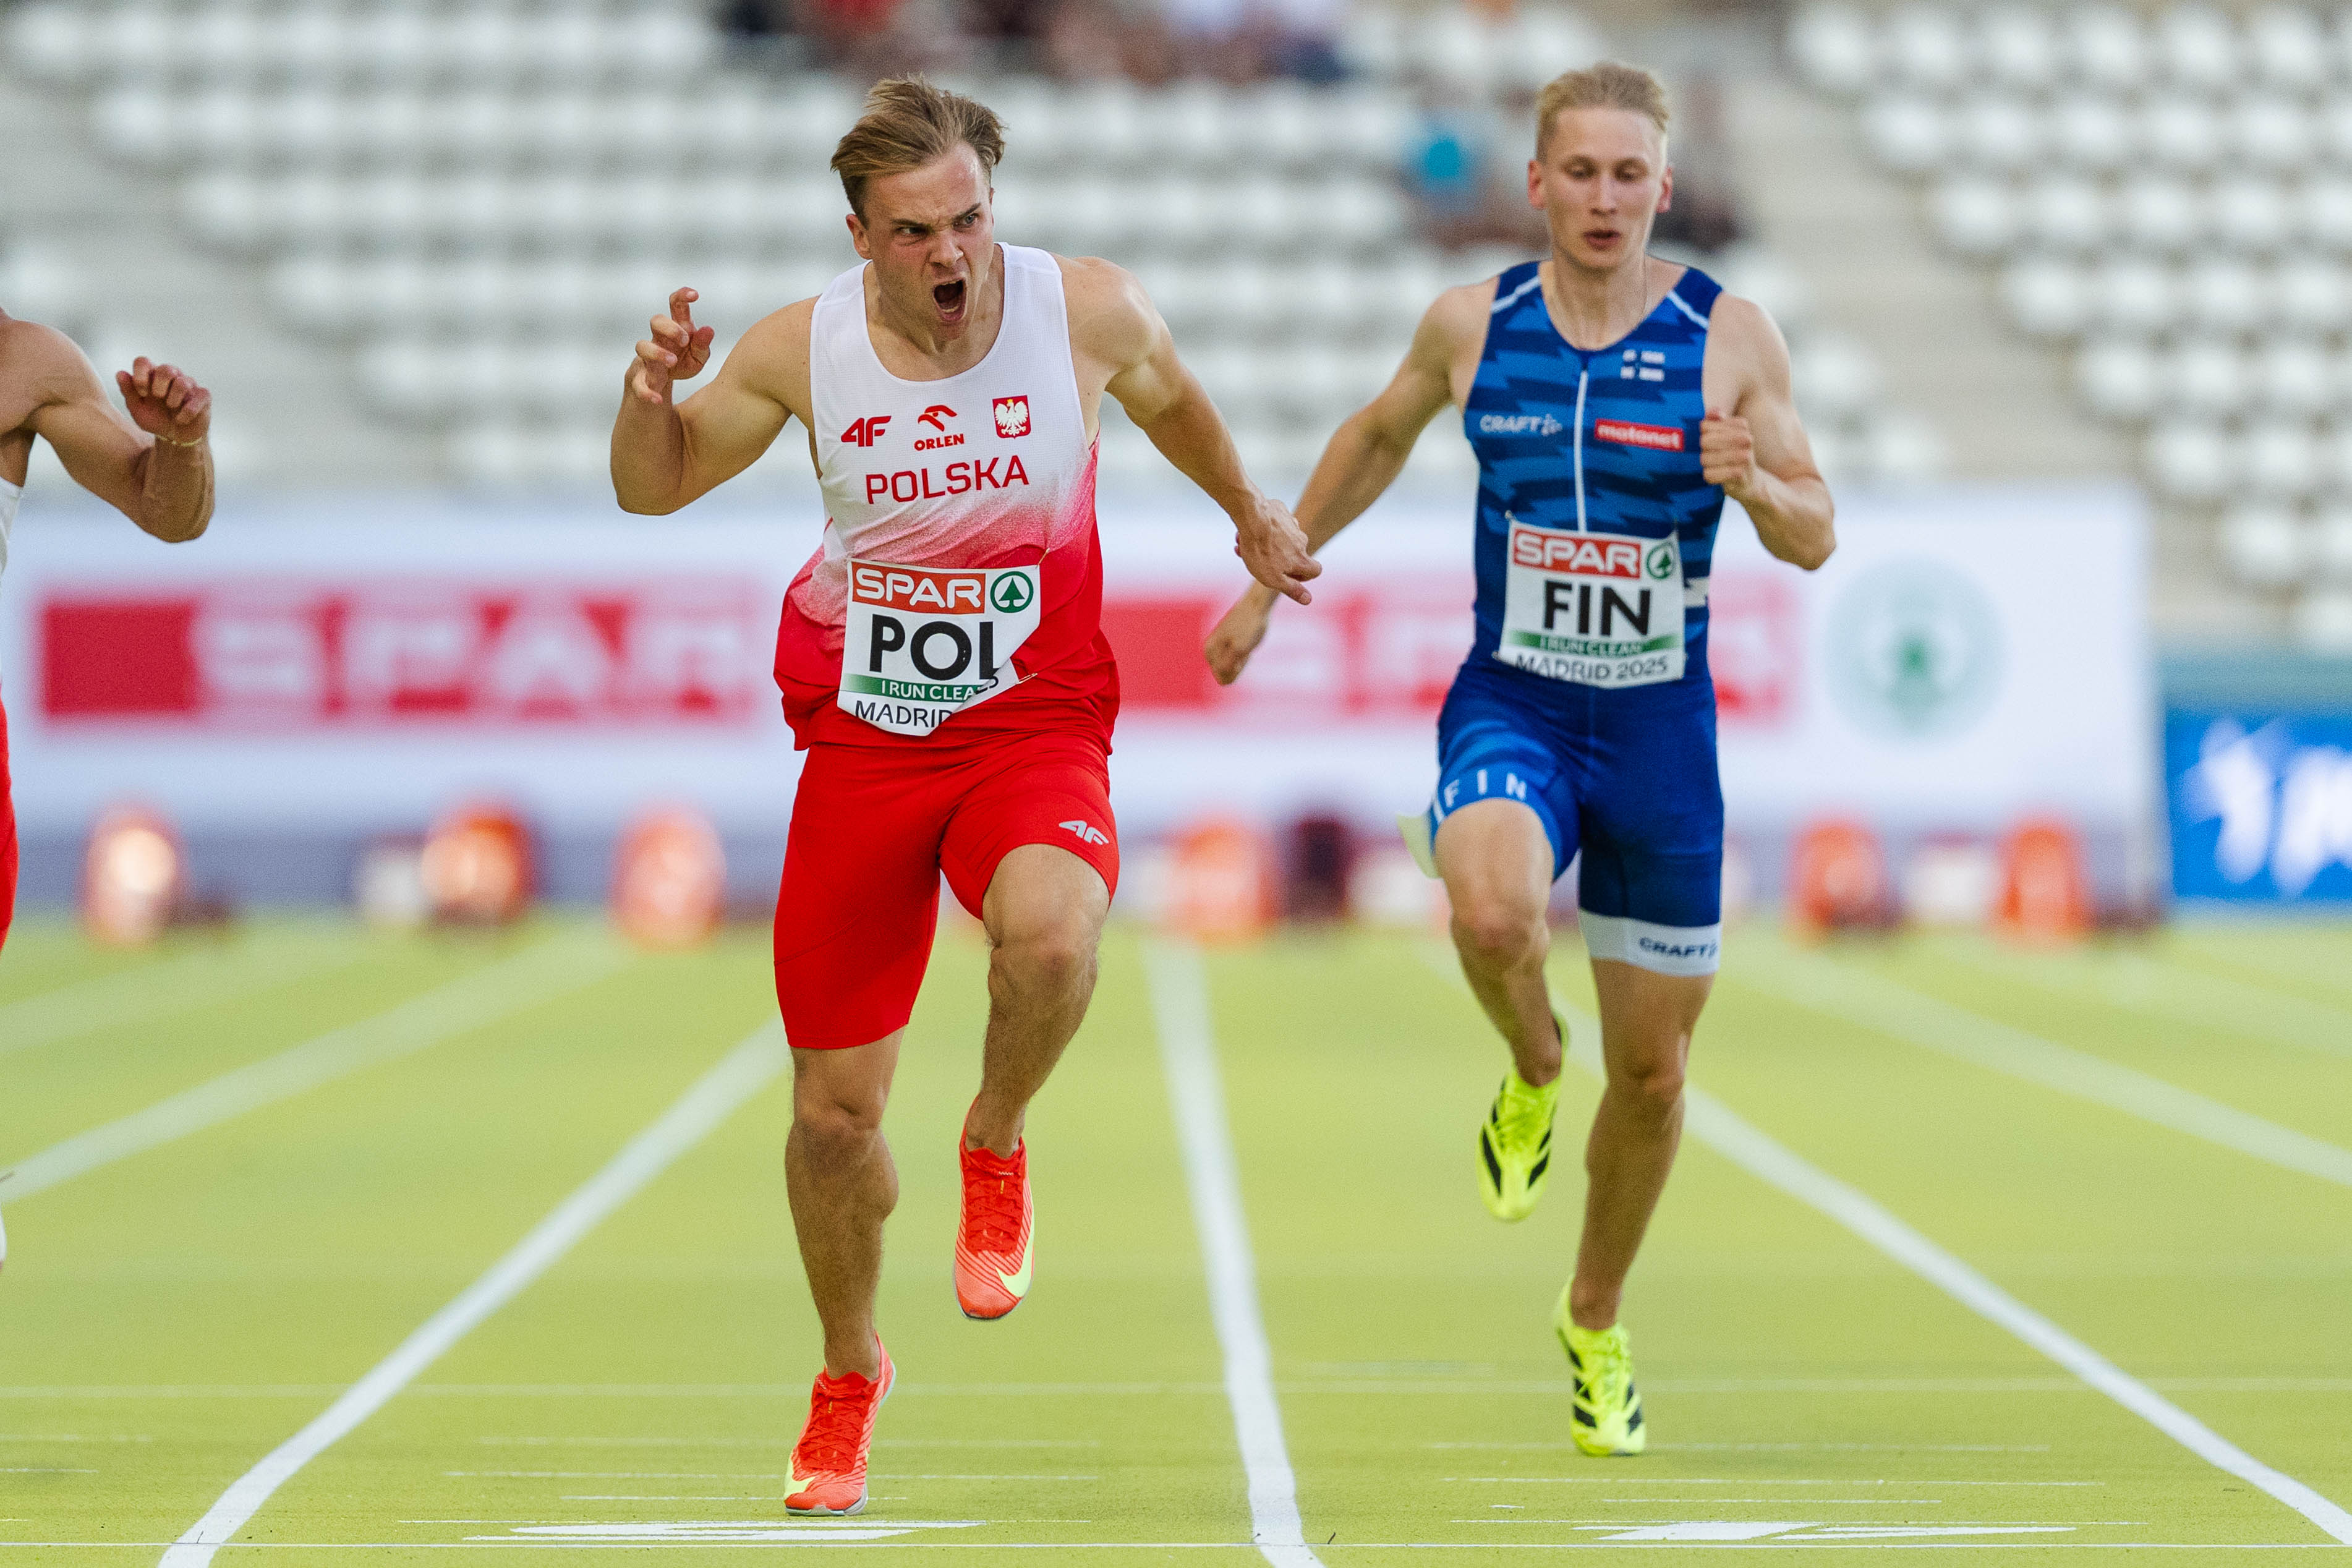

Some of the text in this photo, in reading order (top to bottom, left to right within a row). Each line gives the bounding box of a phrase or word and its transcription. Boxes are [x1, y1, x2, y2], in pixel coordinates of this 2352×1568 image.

[840, 415, 892, 447] 4F
[1480, 414, 1543, 433] CRAFT
[914, 433, 965, 451] ORLEN
[866, 455, 1029, 505] POLSKA
[1515, 532, 1638, 576] SPAR
[856, 567, 982, 609] SPAR
[1543, 580, 1651, 636] FIN
[1515, 653, 1668, 681] MADRID 2025
[881, 680, 886, 694] I
[889, 681, 925, 699] RUN
[929, 685, 981, 701] CLEA
[1444, 769, 1527, 807] FIN
[1059, 820, 1109, 845] 4F
[1640, 936, 1708, 958] CRAFT
